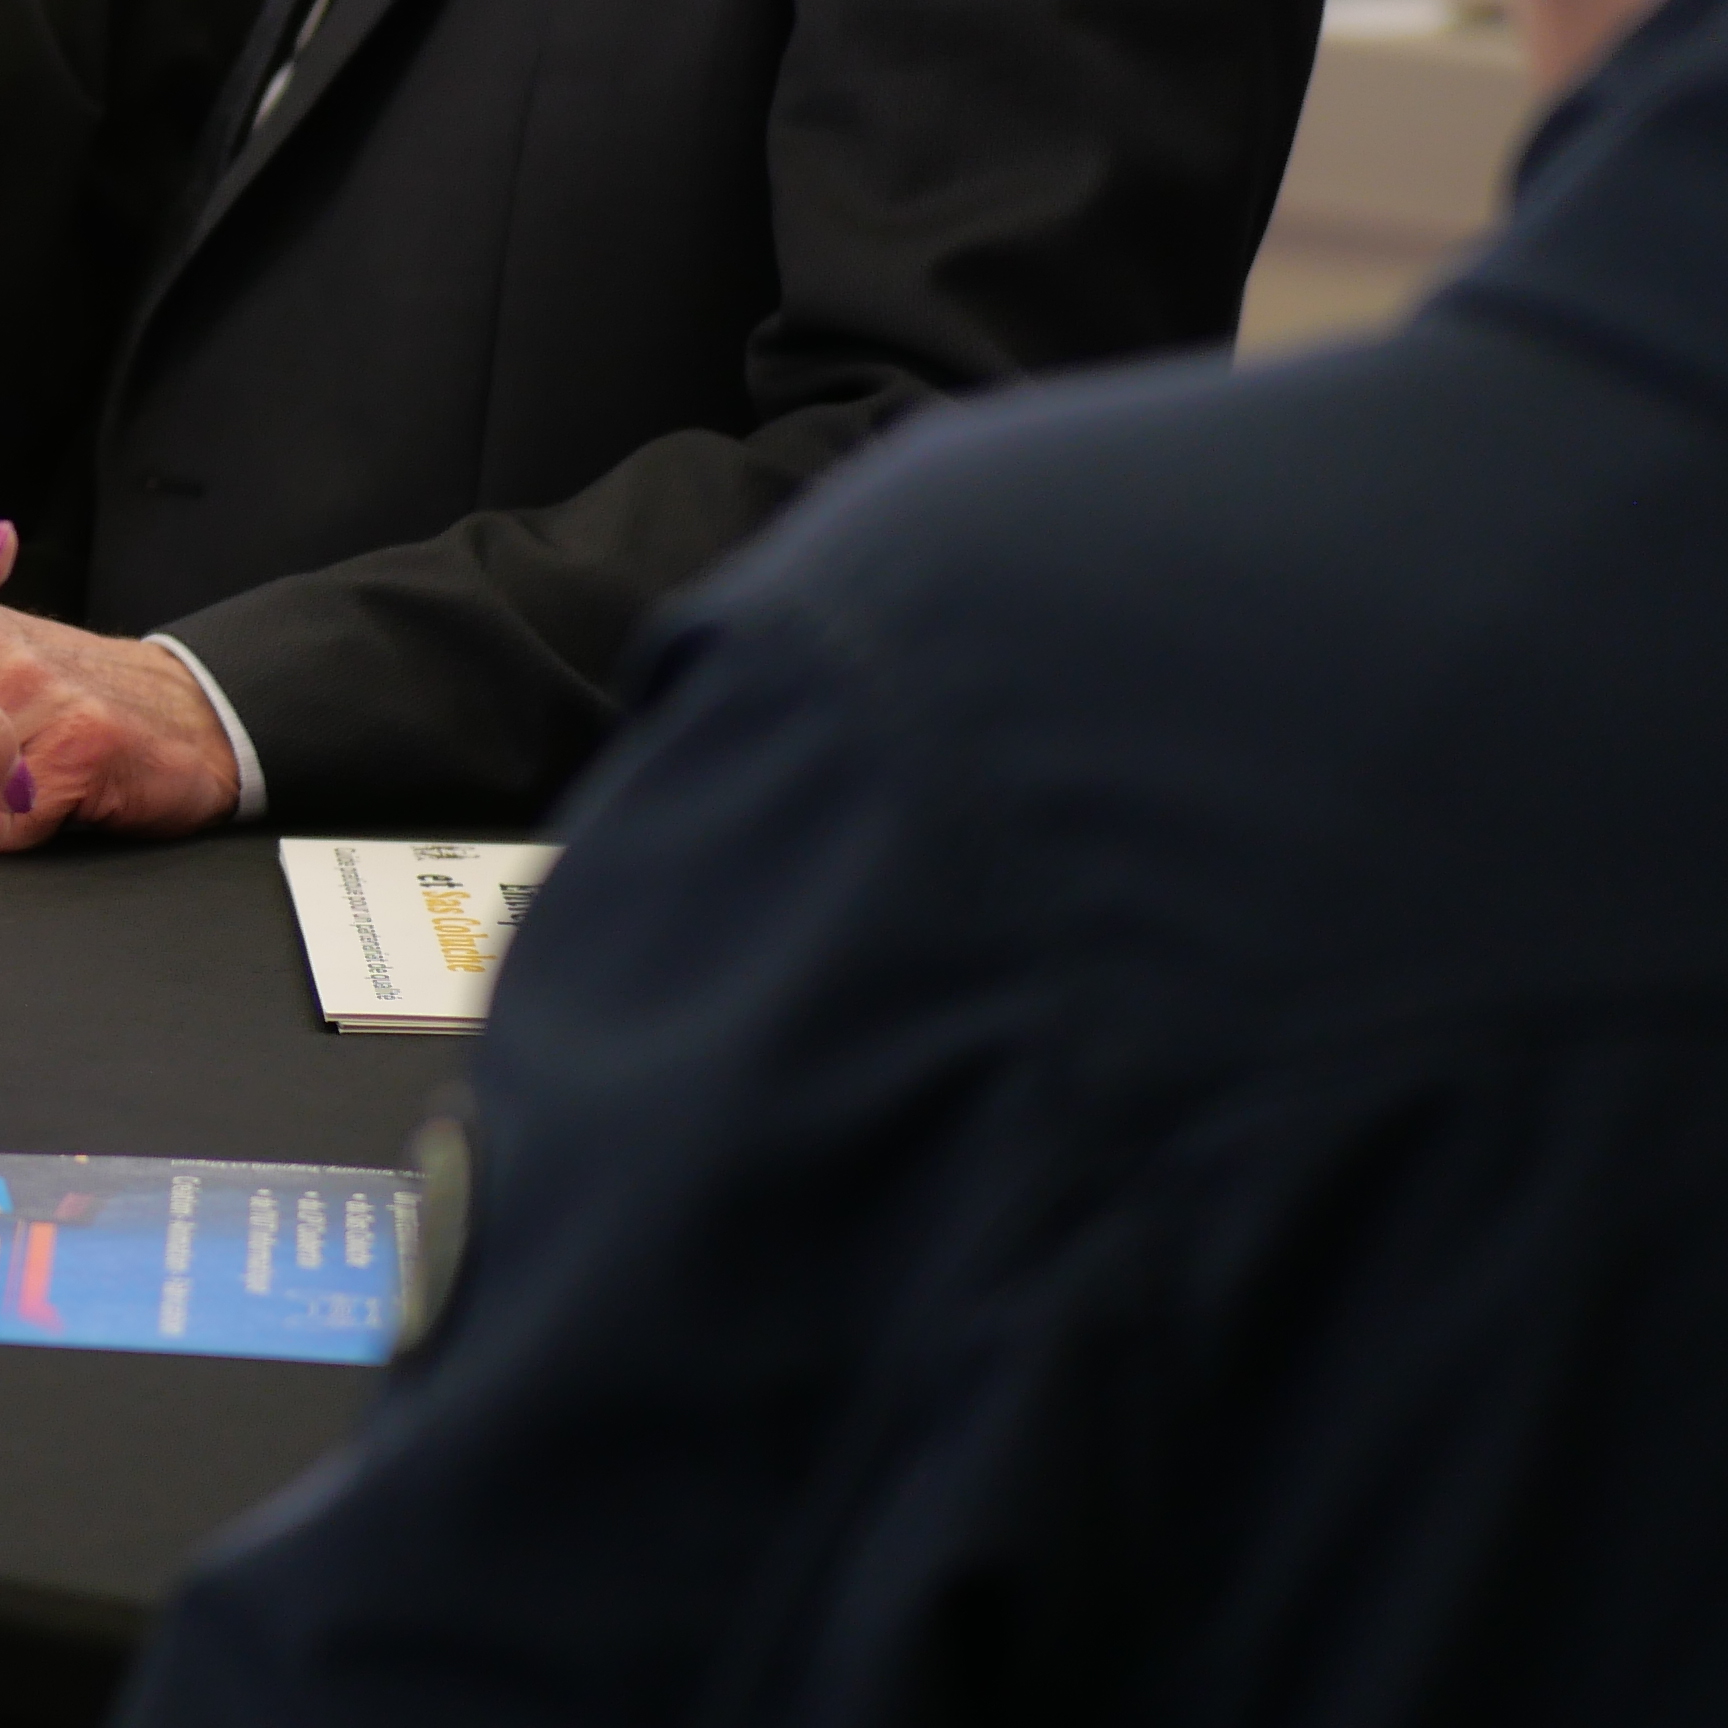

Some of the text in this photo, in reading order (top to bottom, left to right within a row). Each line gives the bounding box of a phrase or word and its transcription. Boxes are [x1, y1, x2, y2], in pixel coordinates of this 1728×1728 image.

[416, 874, 497, 974] et Sas Coluche
[364, 963, 394, 974] de
[364, 974, 403, 1001] qualité
